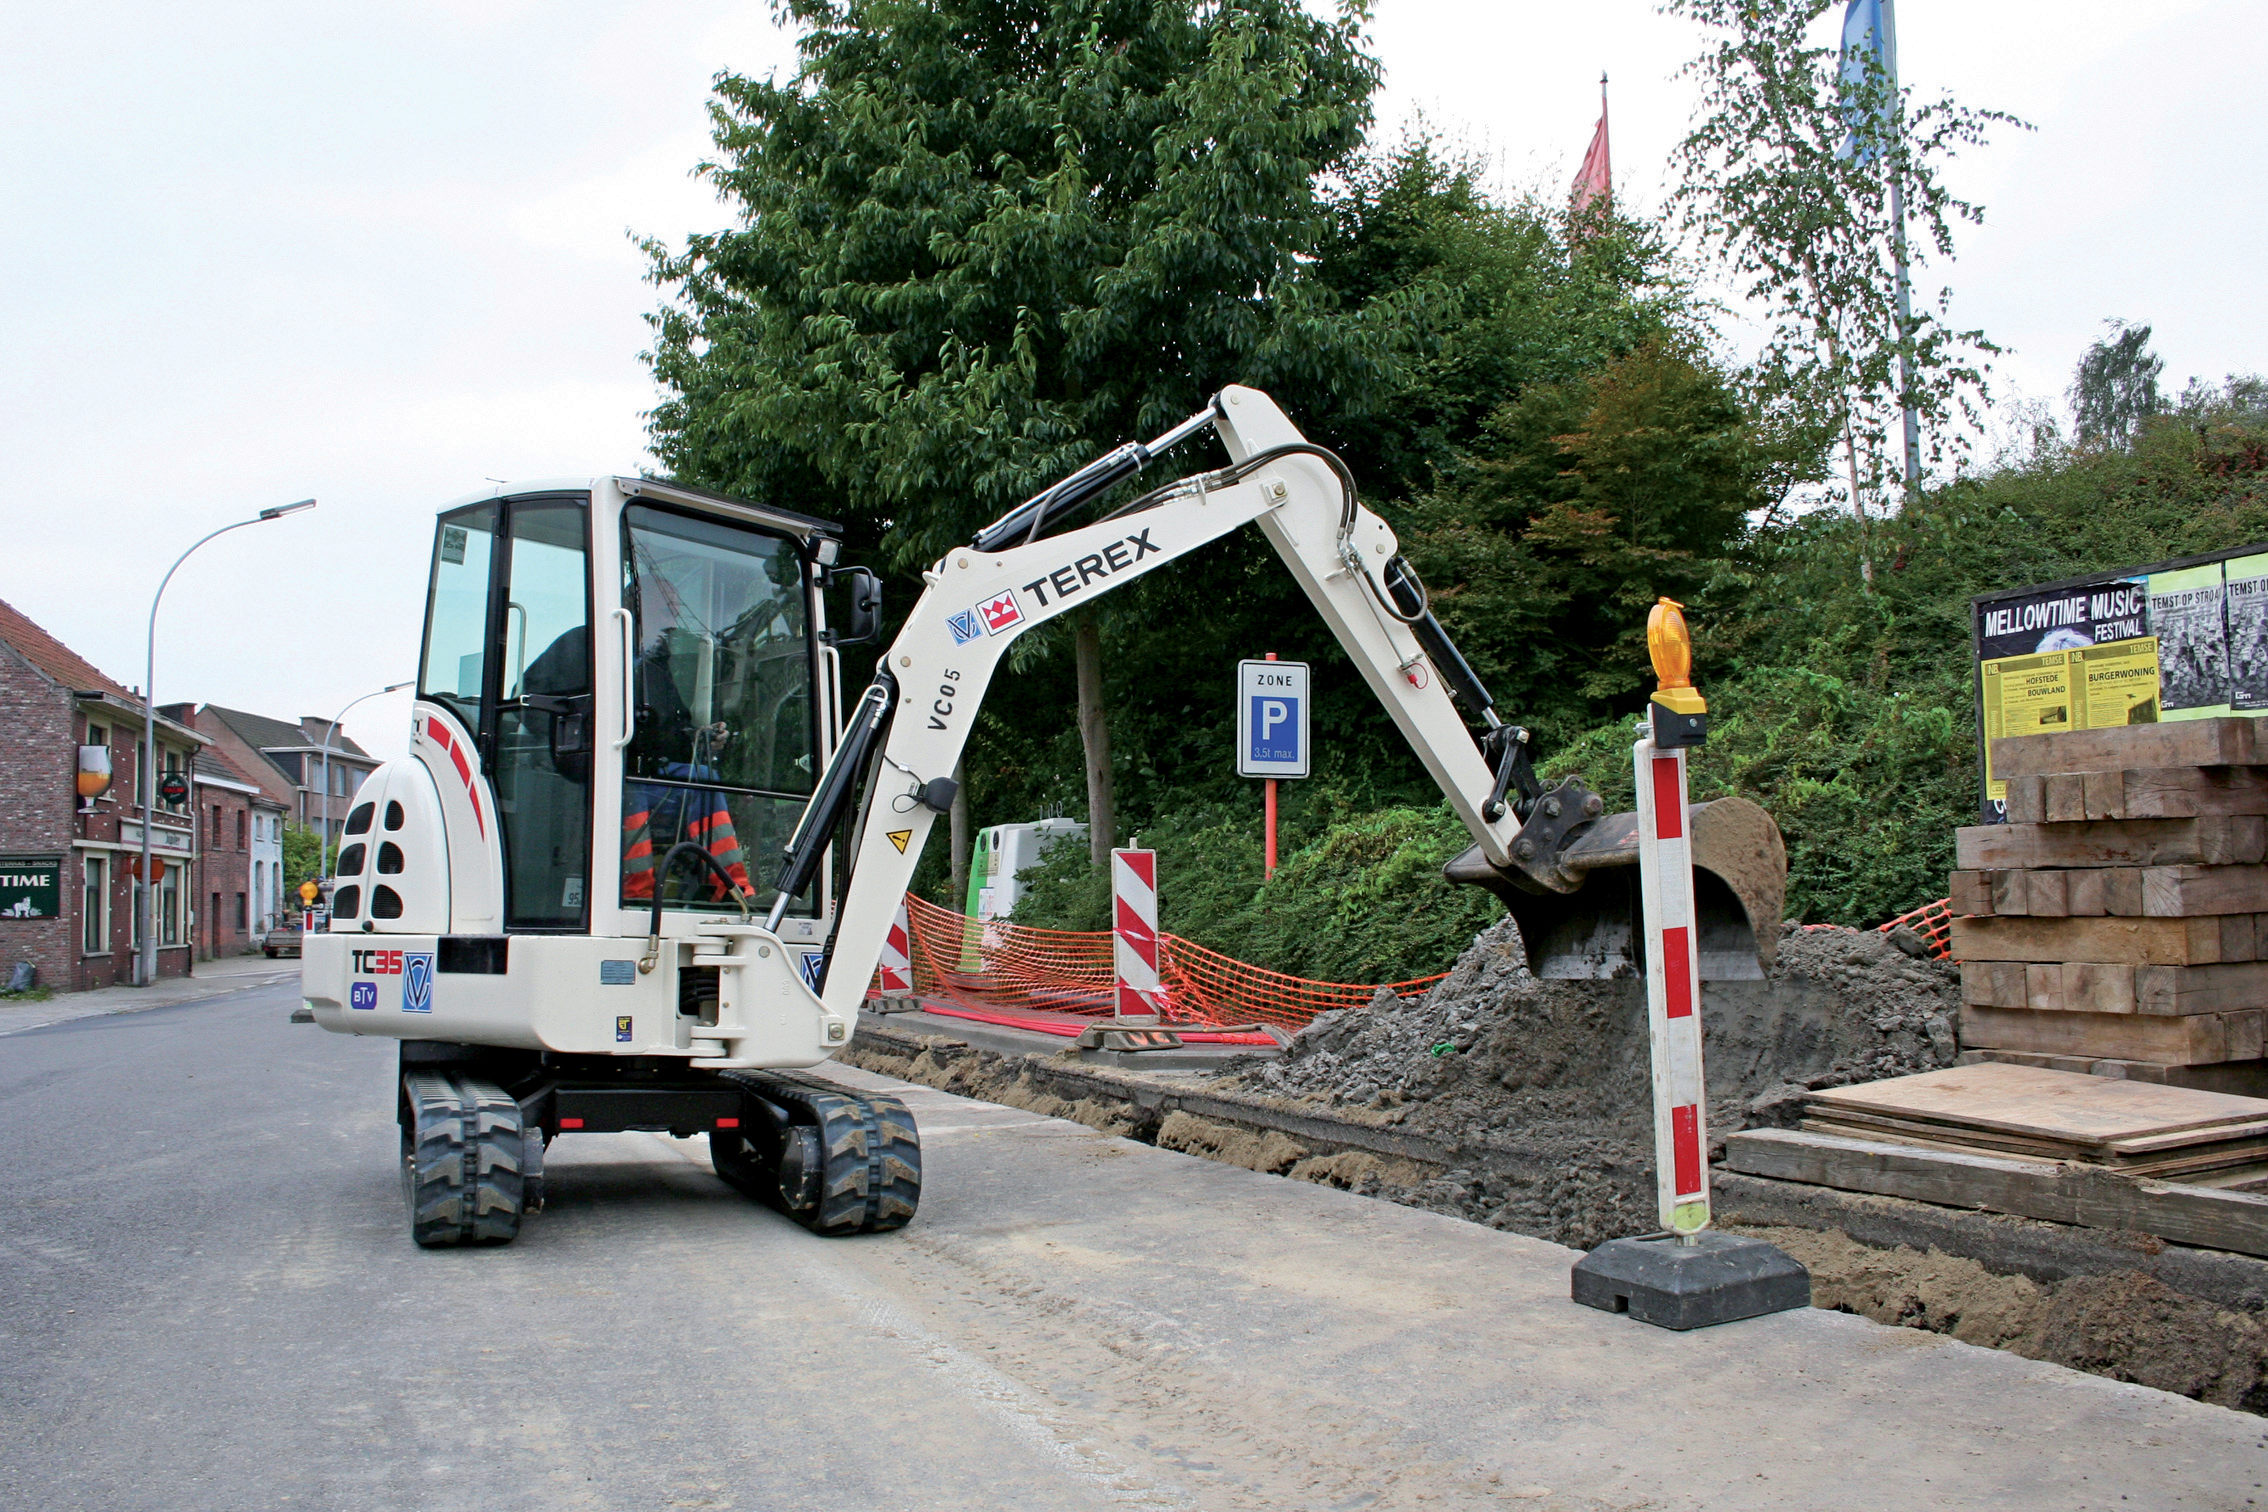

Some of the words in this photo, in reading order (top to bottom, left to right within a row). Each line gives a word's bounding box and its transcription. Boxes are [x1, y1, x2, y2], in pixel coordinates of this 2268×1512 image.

[1022, 527, 1161, 607] TEREX
[2229, 580, 2257, 597] TEMST
[2152, 595, 2179, 610] TEMST
[2181, 593, 2193, 606] OP
[1985, 596, 2086, 638] MELLOWTIME
[2090, 588, 2141, 621] MUSIC
[2094, 619, 2142, 642] FESTIVAL
[2129, 643, 2153, 654] TEMSE
[2041, 655, 2063, 666] TEMSE
[1257, 674, 1292, 686] ZONE
[2025, 674, 2059, 685] HOFSTEDE
[2088, 666, 2155, 682] BURGERWONING
[2027, 685, 2066, 697] BOUWLAND
[927, 668, 961, 732] VC05
[1262, 700, 1288, 741] P
[1254, 747, 1271, 760] 3,5t
[1274, 749, 1295, 759] max.
[0, 874, 51, 887] TIME
[352, 950, 403, 975] TC35
[353, 986, 374, 1005] BTV
